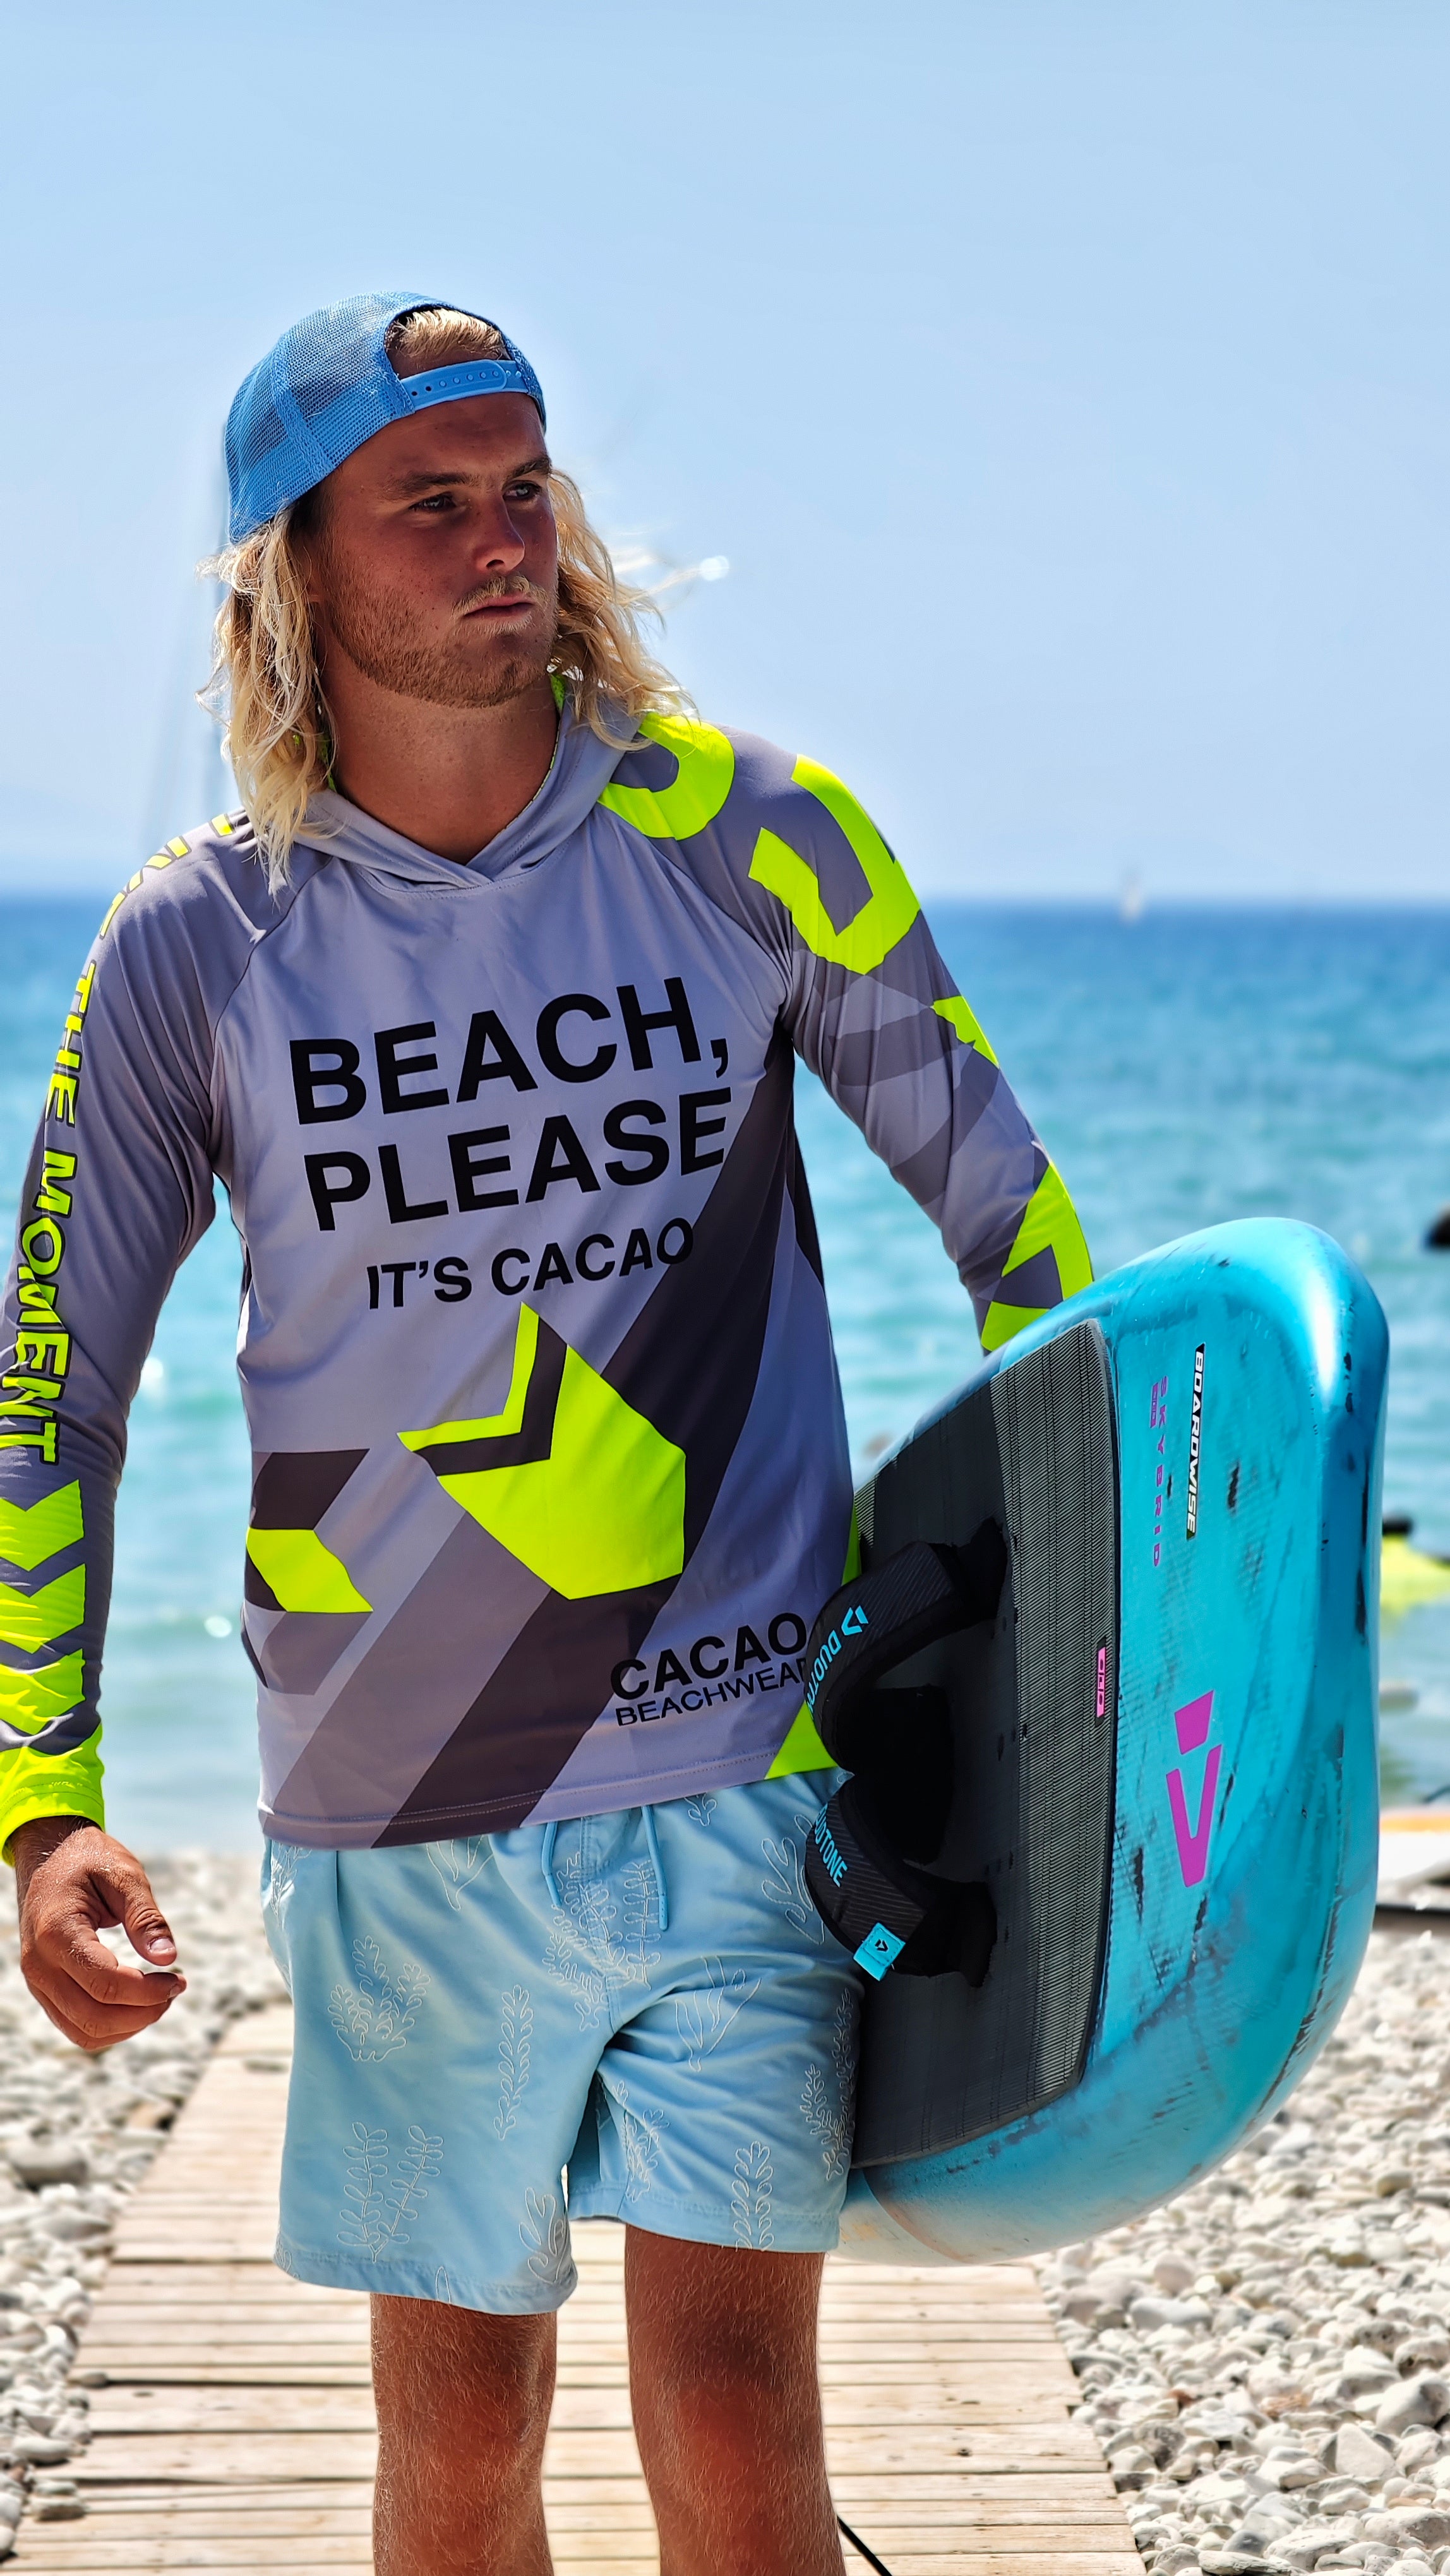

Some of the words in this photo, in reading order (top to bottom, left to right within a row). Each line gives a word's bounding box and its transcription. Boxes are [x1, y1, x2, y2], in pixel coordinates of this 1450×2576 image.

[44, 959, 96, 1129] THE
[289, 976, 728, 1124] BEACH,
[304, 1087, 732, 1231] PLEASE
[0, 1147, 78, 1466] MOMENT
[366, 1256, 472, 1310] IT'S
[491, 1217, 694, 1296] CACAO
[1153, 1375, 1167, 1566] SKYBRID
[1187, 1351, 1204, 1534] BOARDWISE
[610, 1612, 807, 1700] CACAO
